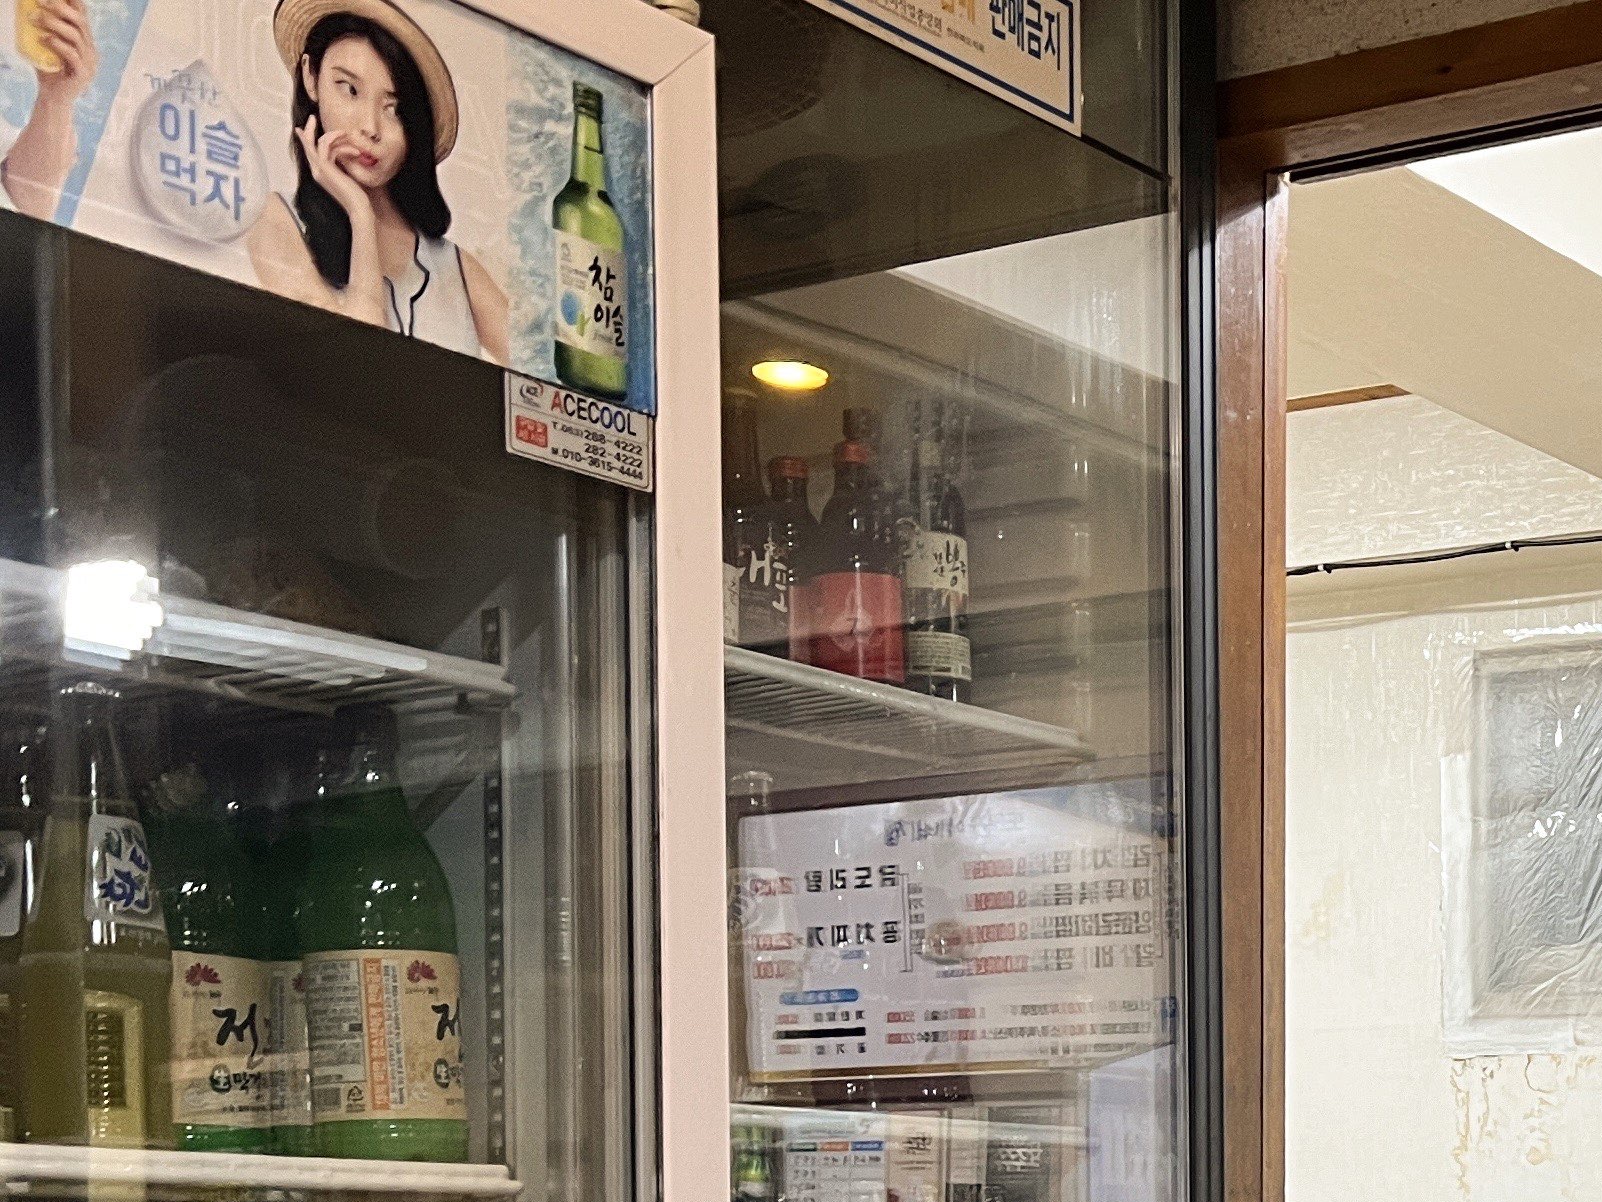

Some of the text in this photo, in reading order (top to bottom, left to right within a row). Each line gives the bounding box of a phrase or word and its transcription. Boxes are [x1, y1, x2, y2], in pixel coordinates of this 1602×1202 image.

[159, 102, 242, 169] 이슬
[159, 152, 246, 221] 먹자
[588, 255, 616, 303] 참
[593, 303, 625, 347] 이슬
[550, 390, 637, 437] ACECOOL
